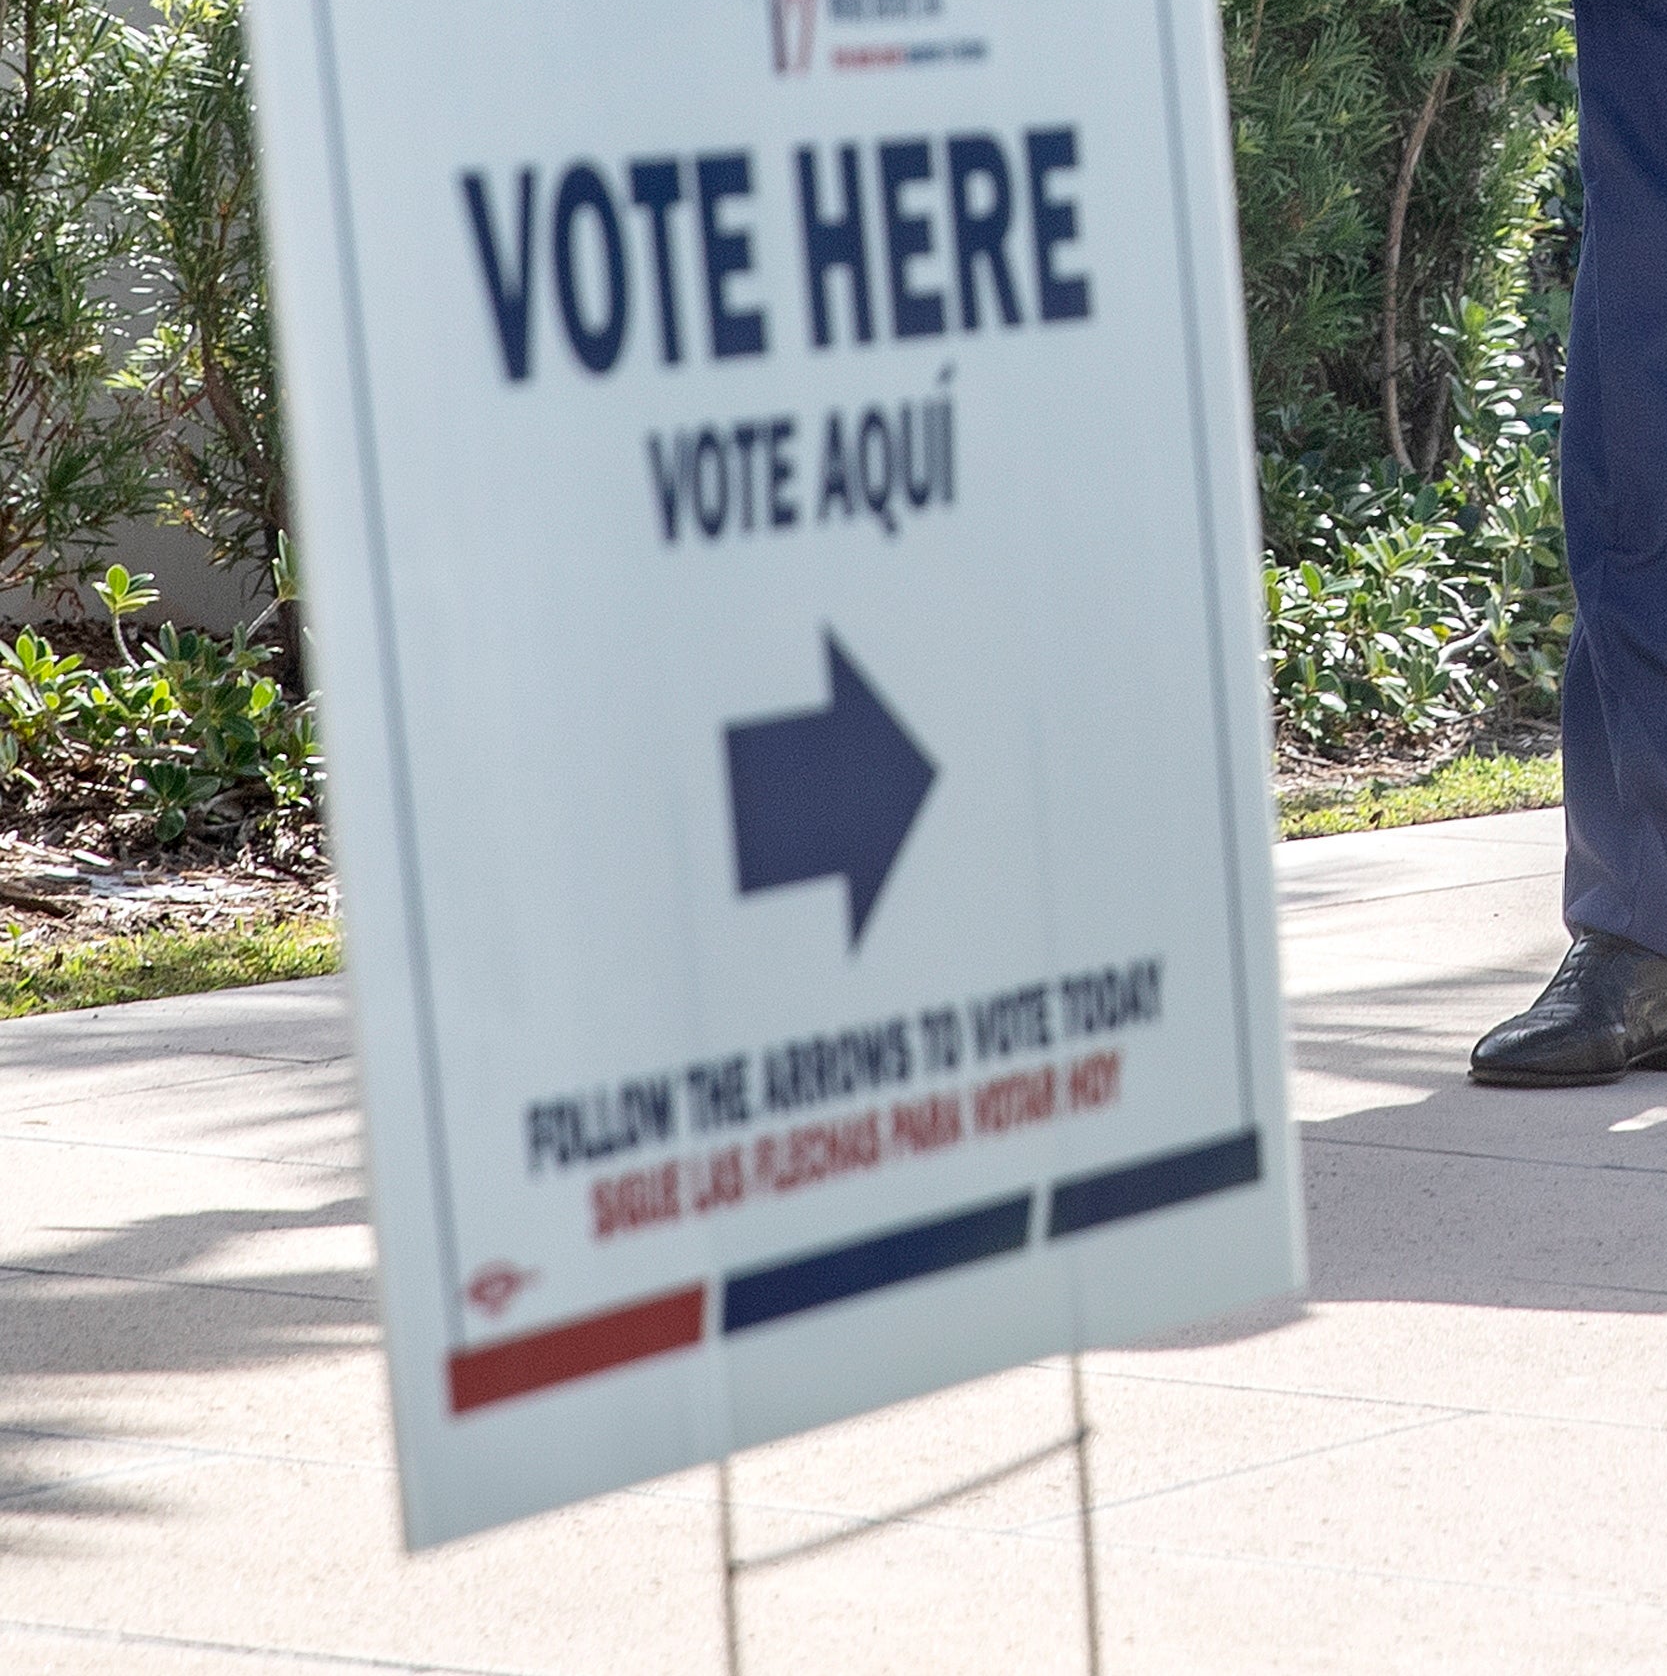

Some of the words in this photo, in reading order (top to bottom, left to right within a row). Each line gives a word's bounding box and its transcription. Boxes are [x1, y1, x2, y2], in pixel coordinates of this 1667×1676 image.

[461, 146, 768, 383] VOTE
[794, 124, 1090, 351] HERE
[646, 417, 800, 543] VOTE
[816, 362, 957, 537] AQUÍ
[526, 1077, 680, 1174] FOLLOW
[686, 1050, 751, 1134] THE
[760, 1016, 911, 1115] ARROWS
[917, 1002, 962, 1072] TO
[966, 981, 1051, 1062] VOTE
[1056, 954, 1164, 1037] TODAY
[590, 1157, 681, 1241] SIGUE
[686, 1139, 746, 1214] LAS
[752, 1106, 881, 1199] FLECHAS
[889, 1090, 963, 1158] PARA
[972, 1062, 1056, 1136] VOTAR
[1065, 1046, 1122, 1113] HOY
